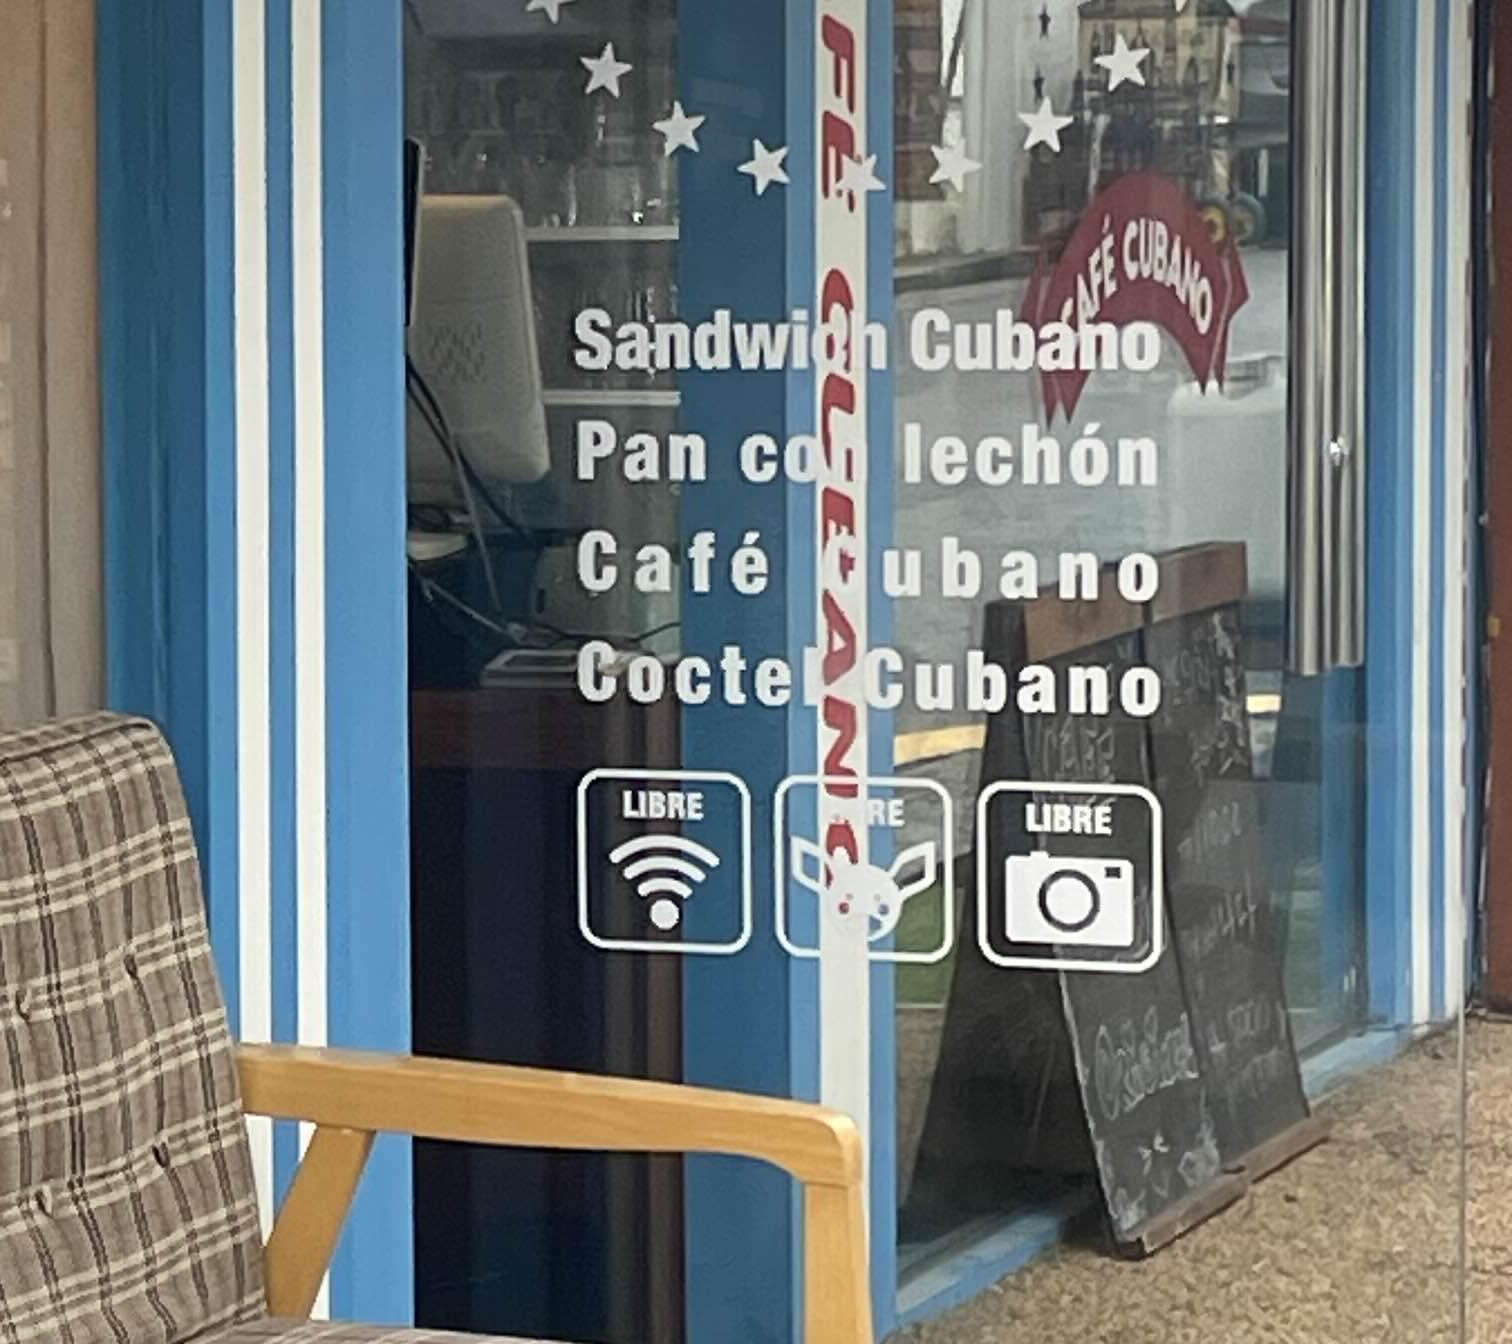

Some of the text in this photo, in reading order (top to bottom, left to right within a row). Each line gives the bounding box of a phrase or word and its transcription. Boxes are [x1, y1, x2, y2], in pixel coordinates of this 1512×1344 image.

[1122, 217, 1213, 336] CUBANO
[910, 307, 1161, 372] Cubano
[575, 420, 707, 483] Pan
[903, 422, 1159, 487] lechón
[575, 528, 769, 596] Café
[861, 645, 1162, 718] Cubano
[621, 789, 705, 823] LIBRE
[1024, 801, 1113, 837] LIBRE
